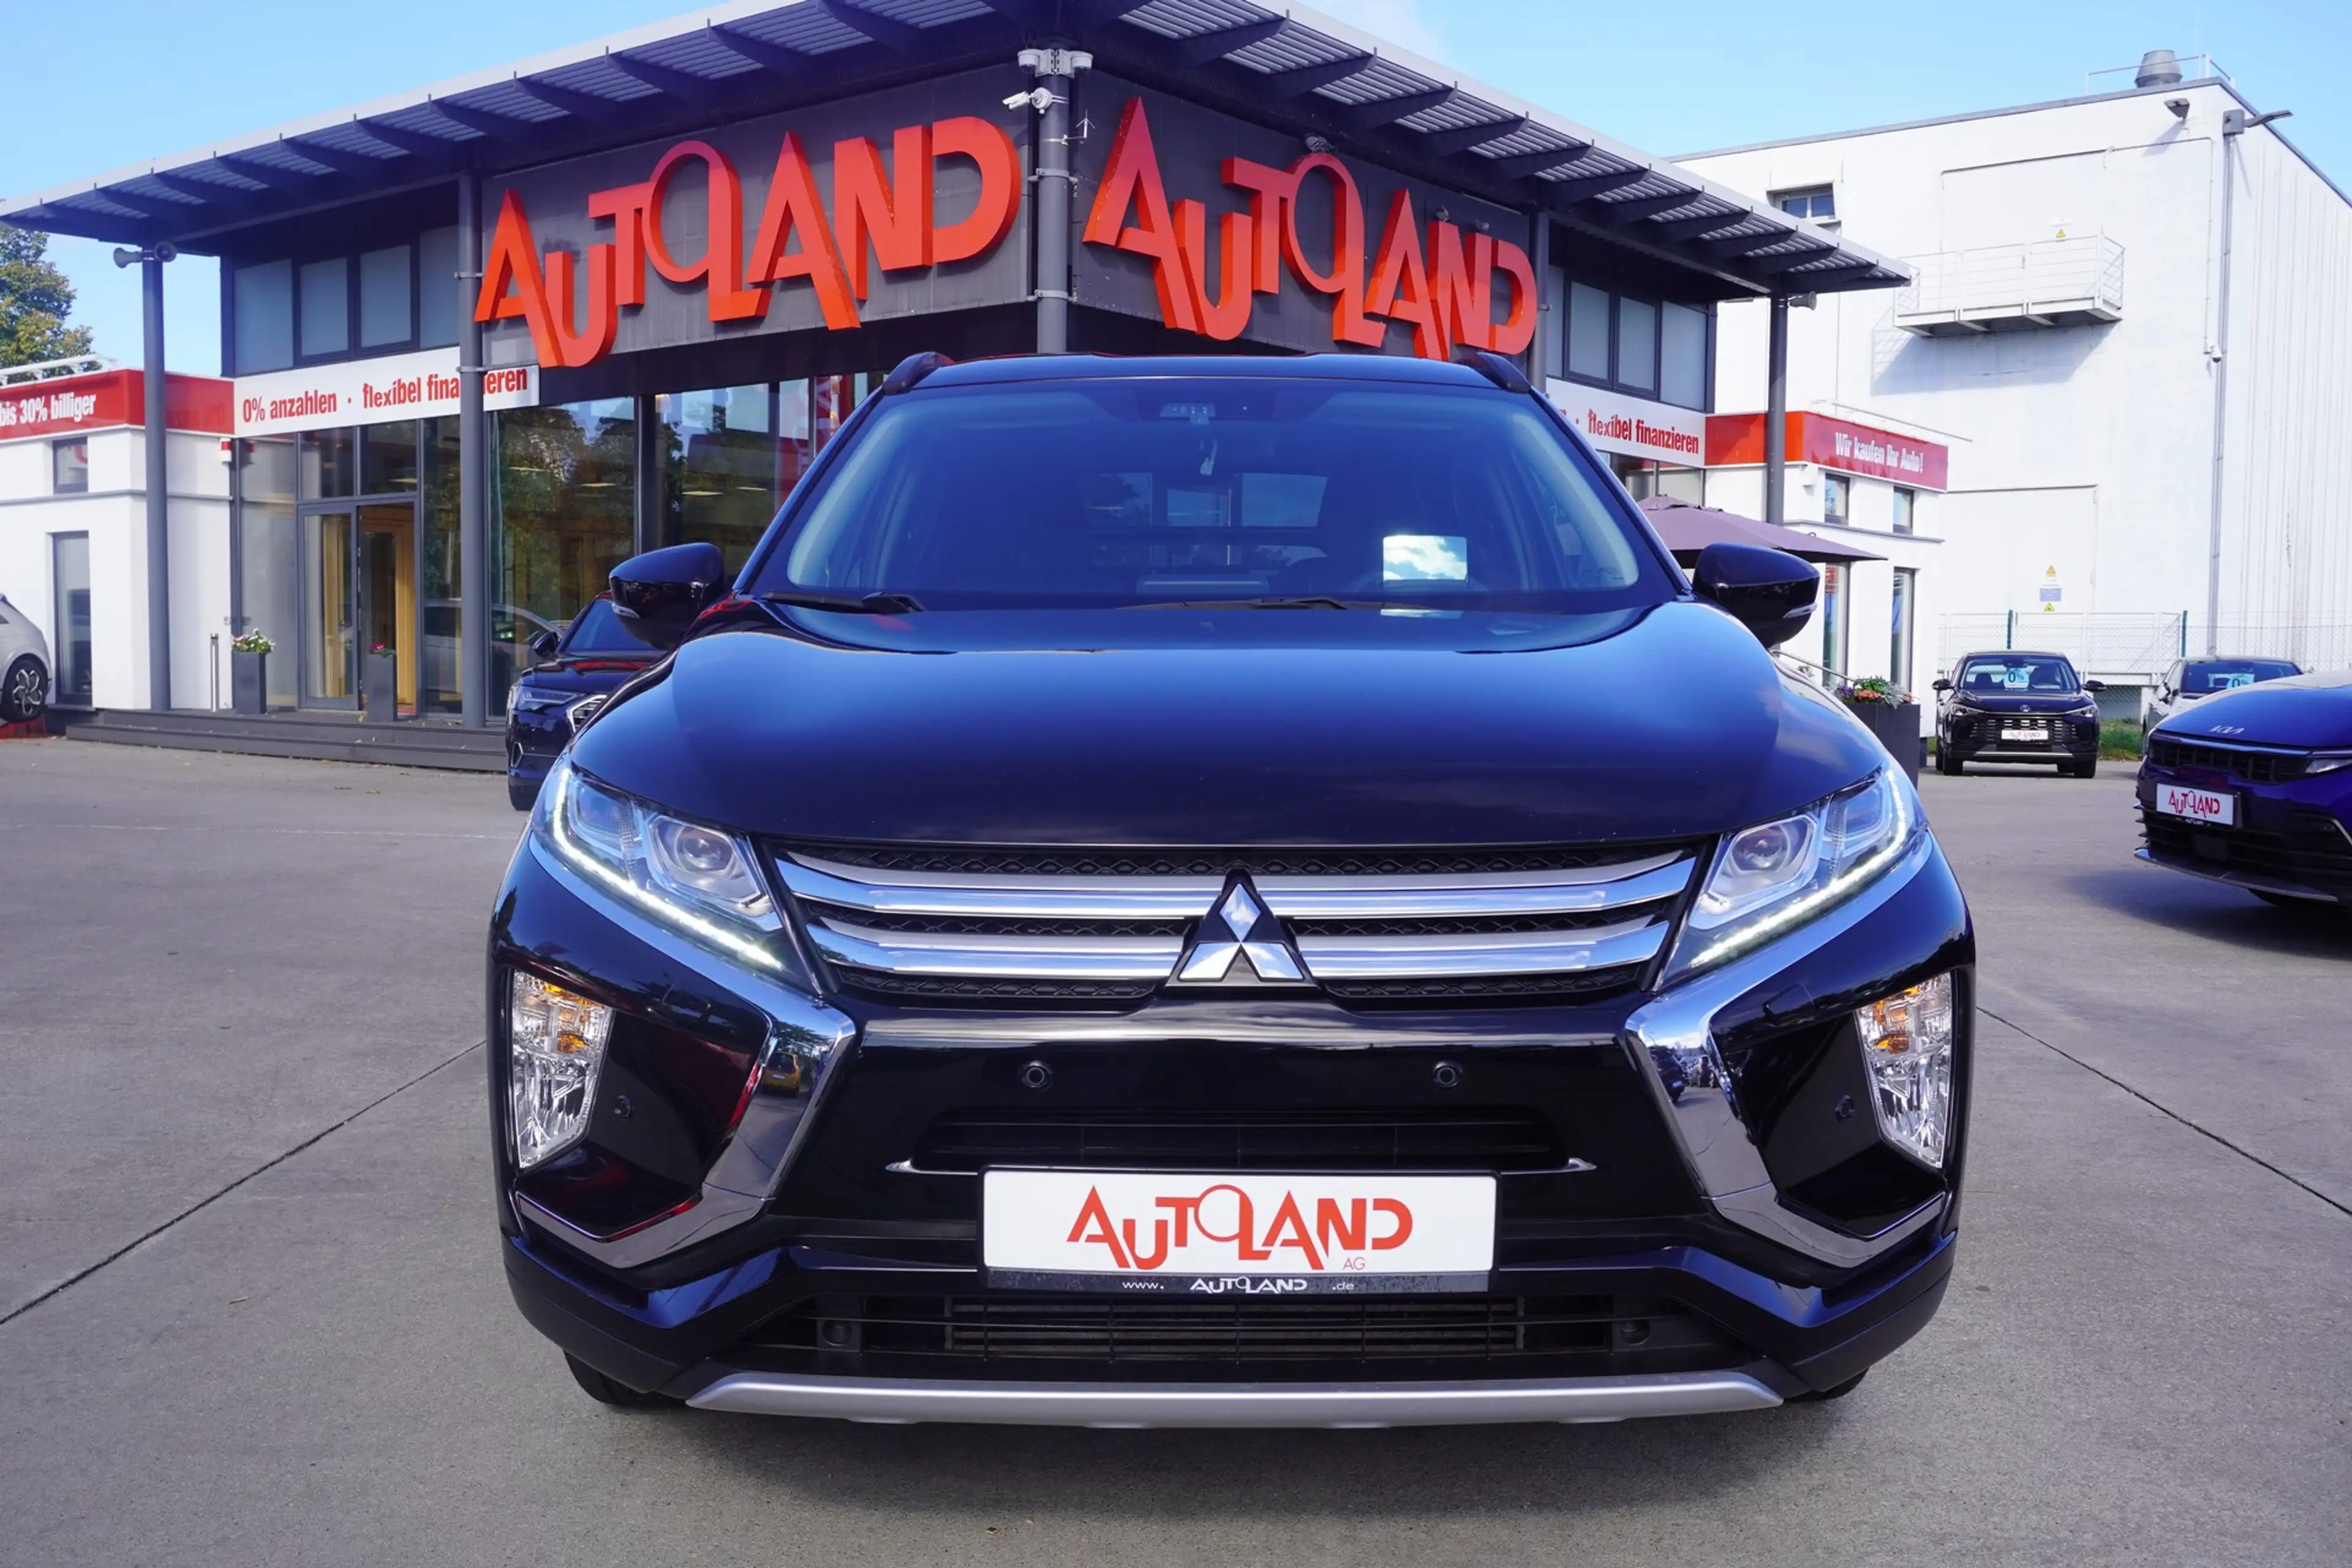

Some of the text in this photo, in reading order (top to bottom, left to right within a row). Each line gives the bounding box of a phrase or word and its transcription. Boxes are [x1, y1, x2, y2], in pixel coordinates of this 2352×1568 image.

[474, 116, 1020, 367] AUTOLAND
[1082, 97, 1537, 362] AUTOLAND
[0, 392, 96, 426] bis 30% billiger
[243, 396, 265, 423] 0%
[270, 390, 337, 420] anzahlen
[363, 377, 421, 409] flexibel
[1588, 409, 1698, 453] flexibel finanzieren
[1835, 432, 1852, 458] Wir
[1854, 436, 1885, 465] kaufen
[1887, 444, 1899, 467] Ihr
[2169, 789, 2220, 819] AUTOLAND
[1066, 1184, 1414, 1270] AUTOLAND
[1343, 1257, 1365, 1270] AG
[1122, 1276, 1355, 1294] www. AUTOLAND .de
